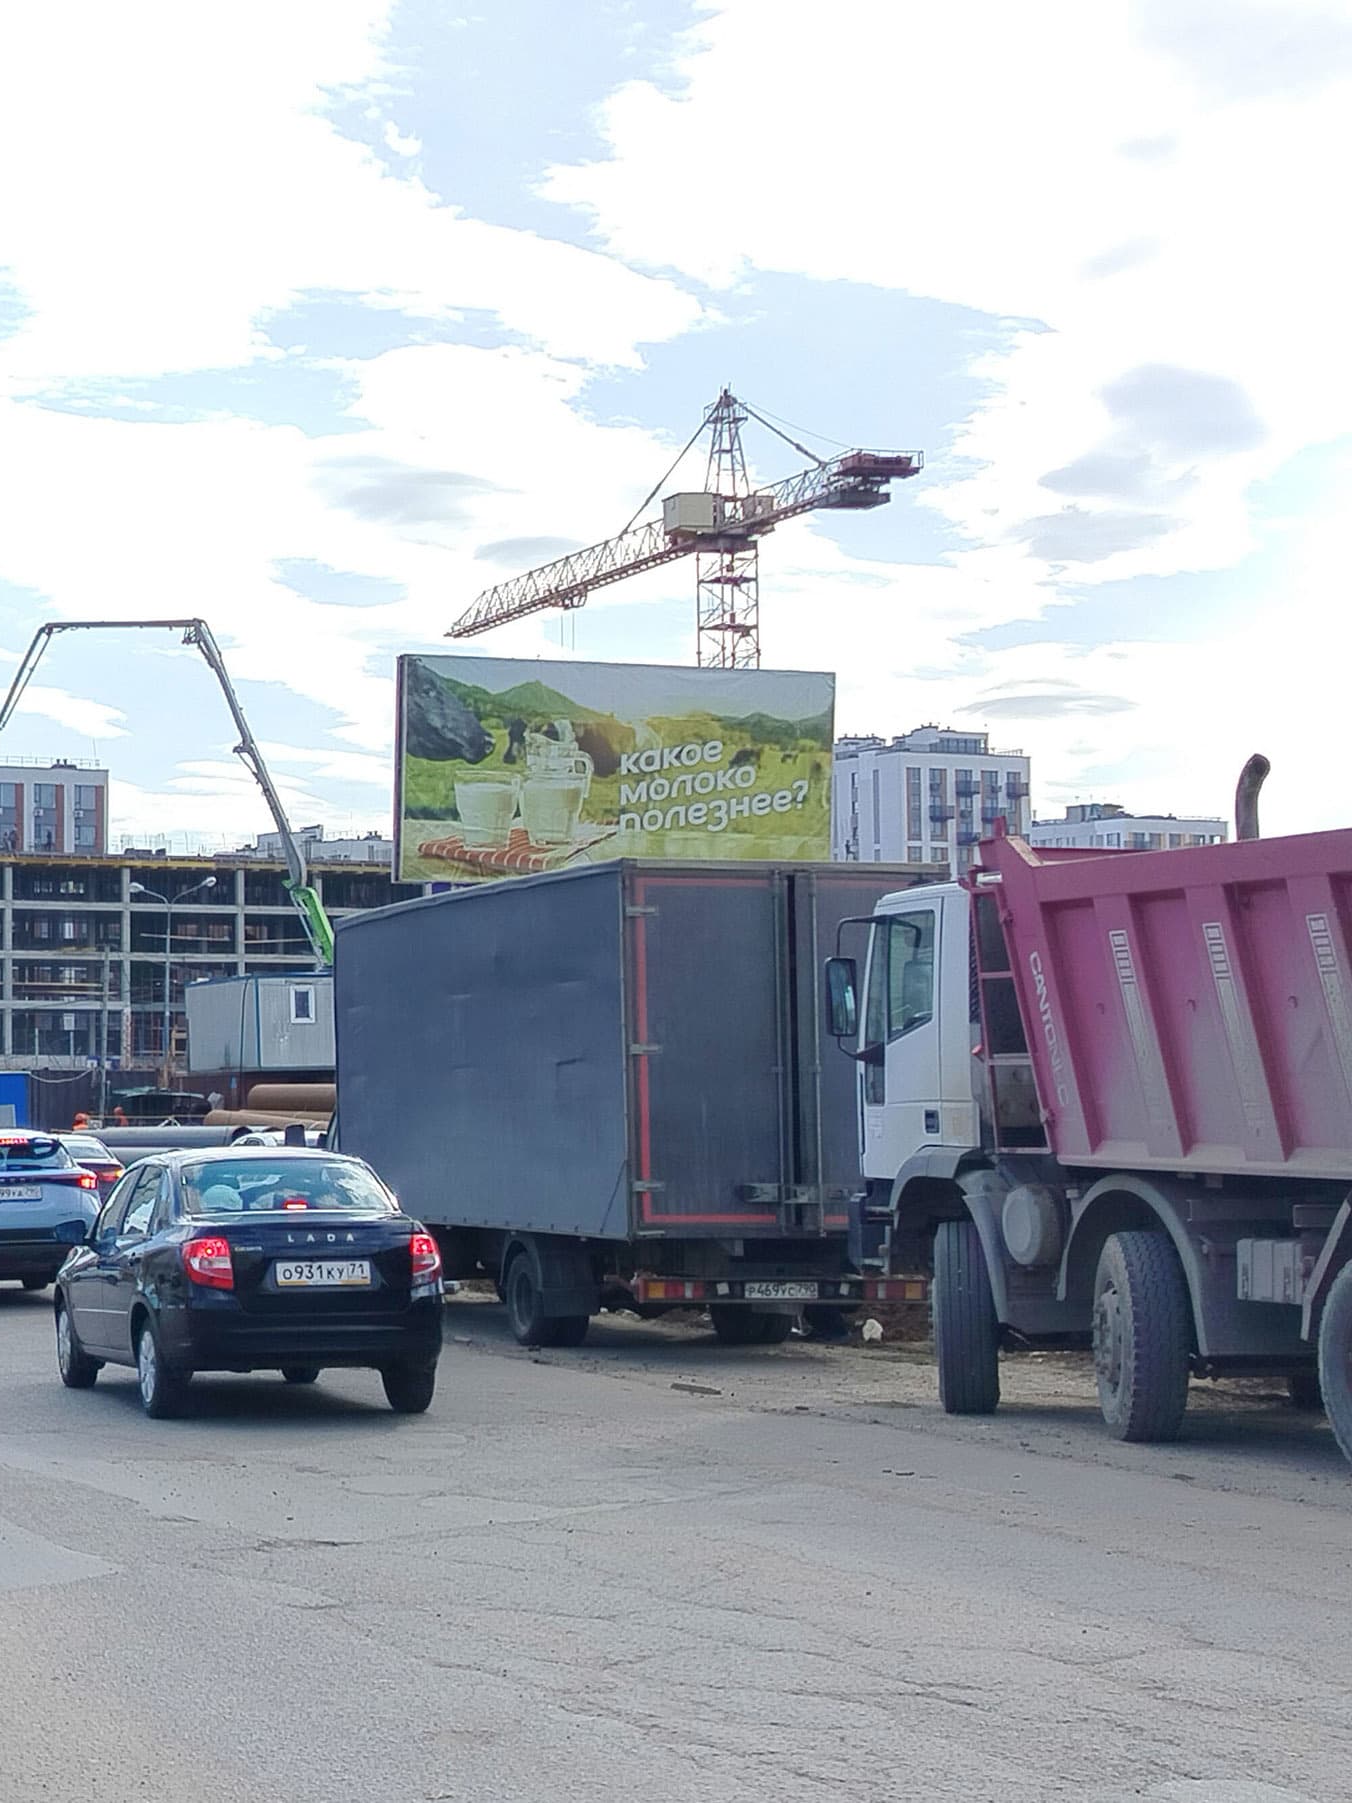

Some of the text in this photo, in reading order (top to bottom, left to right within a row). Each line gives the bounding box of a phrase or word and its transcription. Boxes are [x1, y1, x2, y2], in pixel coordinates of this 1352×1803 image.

[620, 740, 723, 775] какое
[620, 765, 756, 806] молоко
[619, 780, 809, 832] полезнее?
[287, 1233, 354, 1243] LADA
[349, 1263, 365, 1275] 71
